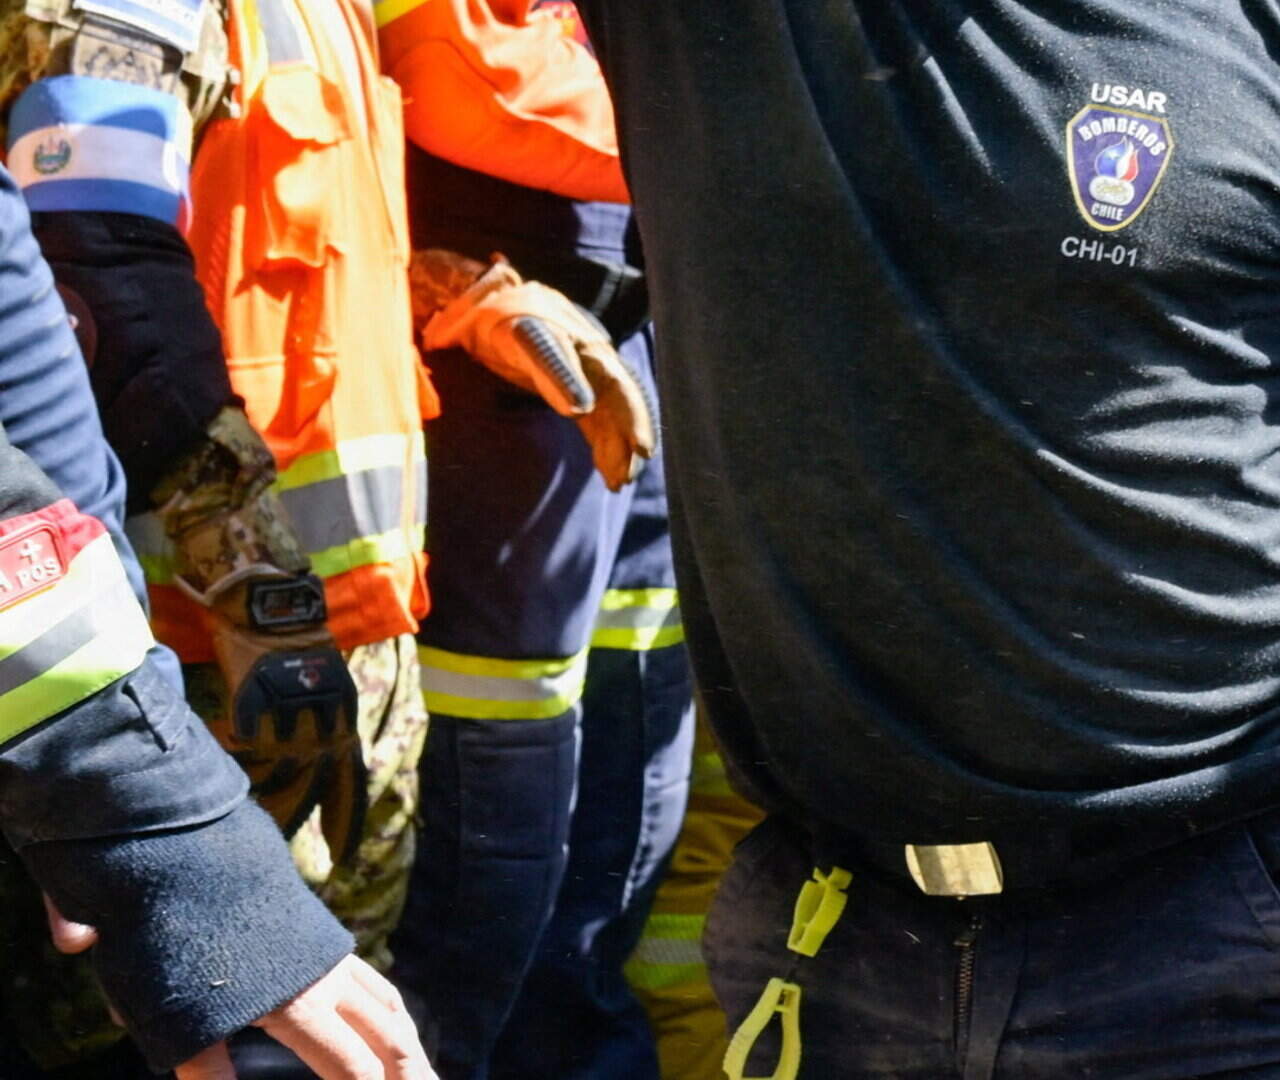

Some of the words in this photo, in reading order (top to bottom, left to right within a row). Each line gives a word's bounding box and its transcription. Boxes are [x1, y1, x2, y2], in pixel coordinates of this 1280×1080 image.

[1090, 82, 1168, 113] USAR
[1077, 116, 1167, 157] BOMBEROS
[1090, 202, 1126, 221] CHILE
[1060, 236, 1138, 268] CHI-01
